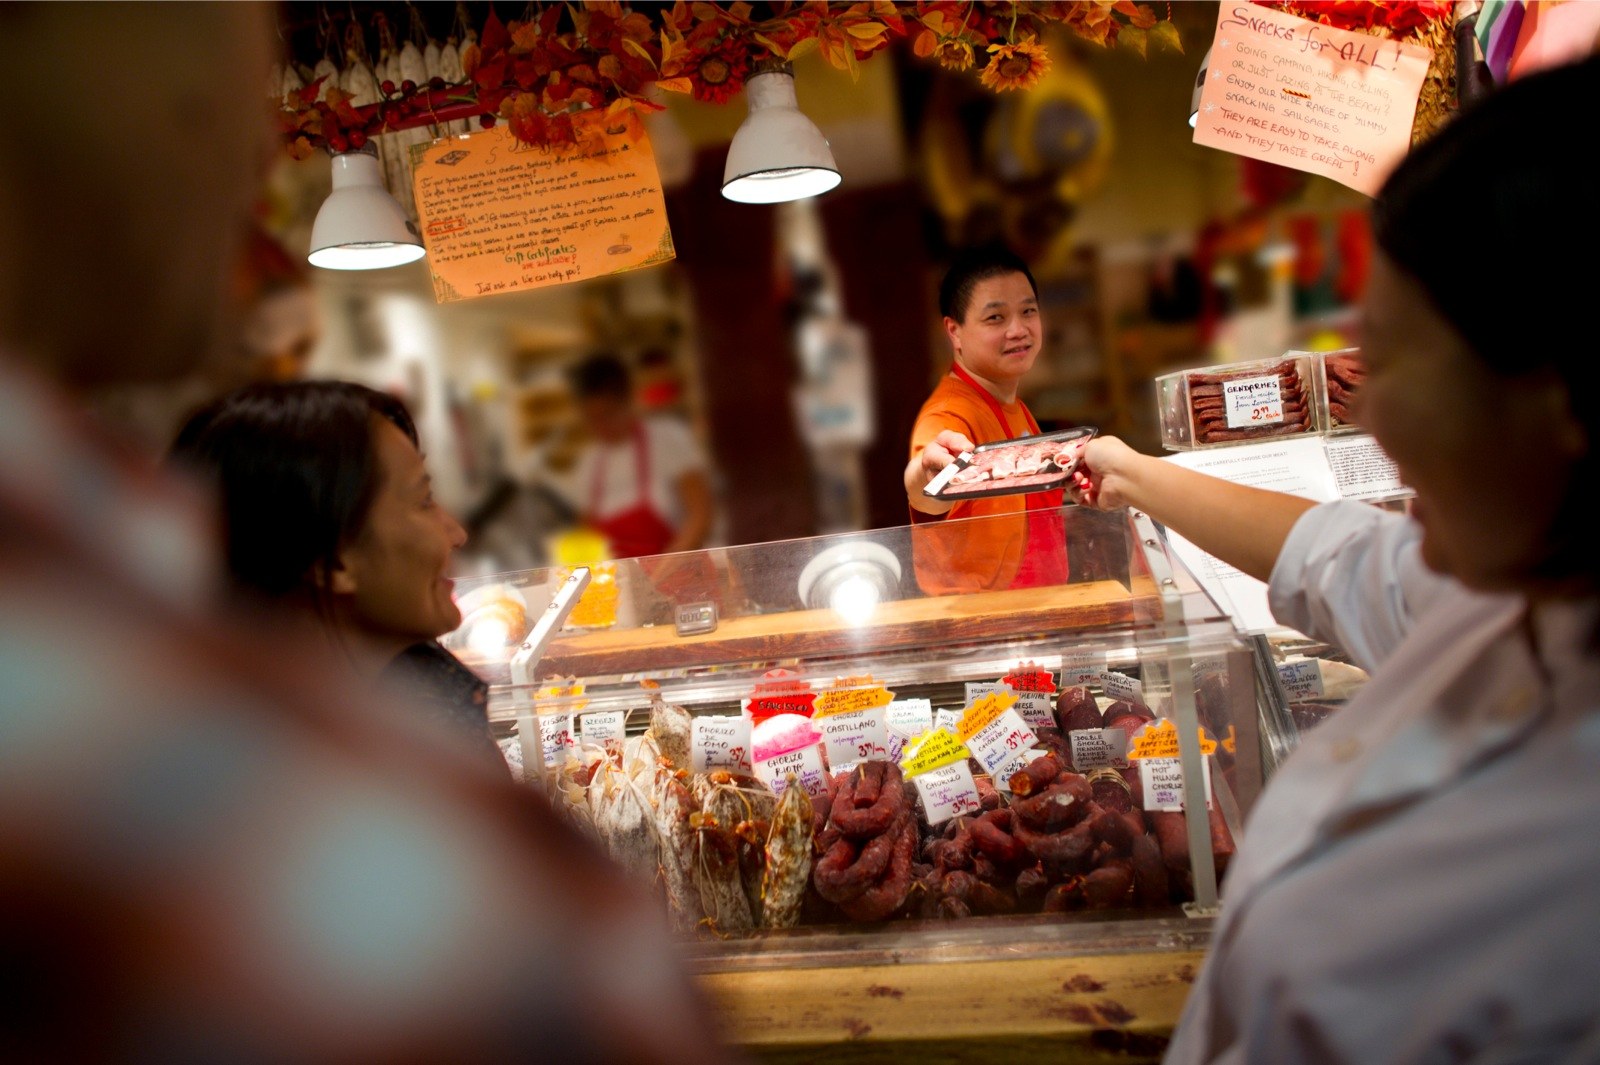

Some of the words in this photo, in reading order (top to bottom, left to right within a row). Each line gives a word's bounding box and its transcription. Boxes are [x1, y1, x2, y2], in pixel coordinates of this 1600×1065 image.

[1220, 7, 1295, 41] SNACKS
[1300, 26, 1332, 53] for
[1236, 41, 1268, 60] GOING
[1232, 59, 1245, 70] OR
[1247, 63, 1275, 79] JUST
[1276, 72, 1310, 92] LAZING
[1328, 87, 1345, 103] THE
[1349, 93, 1390, 116] BEACH?
[1225, 92, 1275, 113] SNACKING
[1226, 74, 1255, 94] ENJOY
[1259, 86, 1276, 98] OUR
[1280, 92, 1302, 106] WIDE
[1306, 100, 1335, 118] RANGE
[1338, 109, 1351, 121] OF
[1355, 115, 1388, 136] YUMMY
[1212, 126, 1242, 141] AND
[1246, 133, 1275, 153] THEY
[1276, 141, 1309, 159] TASTE
[1220, 106, 1244, 123] THEY
[1246, 115, 1268, 130] ARE
[1270, 123, 1296, 139] EASY
[1298, 129, 1309, 141] TO
[1312, 134, 1340, 152] TAKE
[1342, 144, 1376, 165] ALONG
[505, 251, 524, 265] Gift
[527, 244, 577, 263] Certificates
[1227, 381, 1277, 393] GENDARMES
[1213, 458, 1240, 466] CAREFULLY
[1241, 454, 1261, 462] CHOOSE
[700, 726, 736, 736] CHORIZO
[827, 719, 876, 734] CASTILLANO
[978, 726, 1008, 752] CHORIZO
[1074, 734, 1103, 742] DOUBLE
[1147, 730, 1177, 740] GREAT
[698, 741, 729, 749] LOMO
[1076, 744, 1116, 752] MENNONITE
[767, 752, 803, 768] CHORIZO
[1138, 749, 1156, 757] FAST
[925, 774, 961, 790] CHORIZO
[1152, 774, 1183, 782] HUNGA
[1152, 783, 1184, 791] CHORIZ
